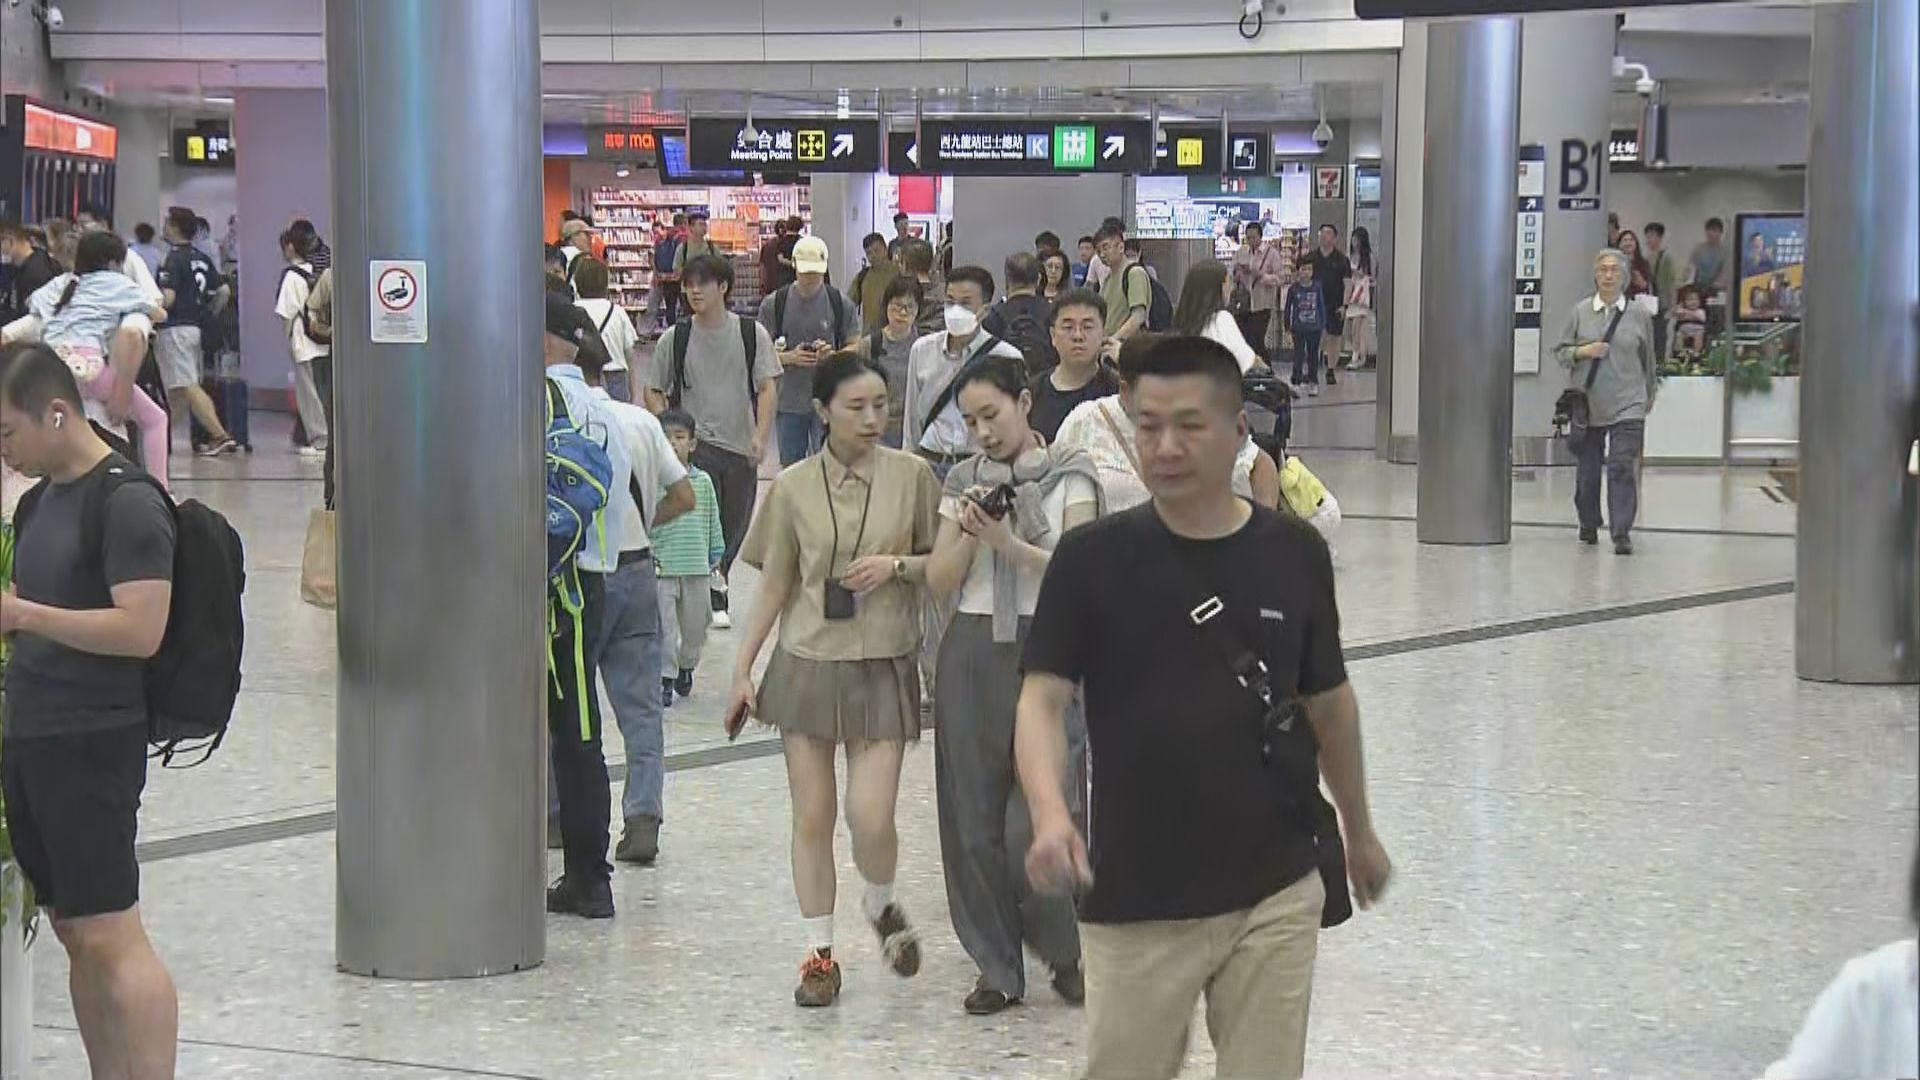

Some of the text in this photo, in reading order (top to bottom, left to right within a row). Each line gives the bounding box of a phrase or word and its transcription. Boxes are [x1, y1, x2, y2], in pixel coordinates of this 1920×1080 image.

[731, 149, 793, 162] Meeting Point
[1032, 136, 1044, 157] K
[1559, 138, 1602, 195] B1
